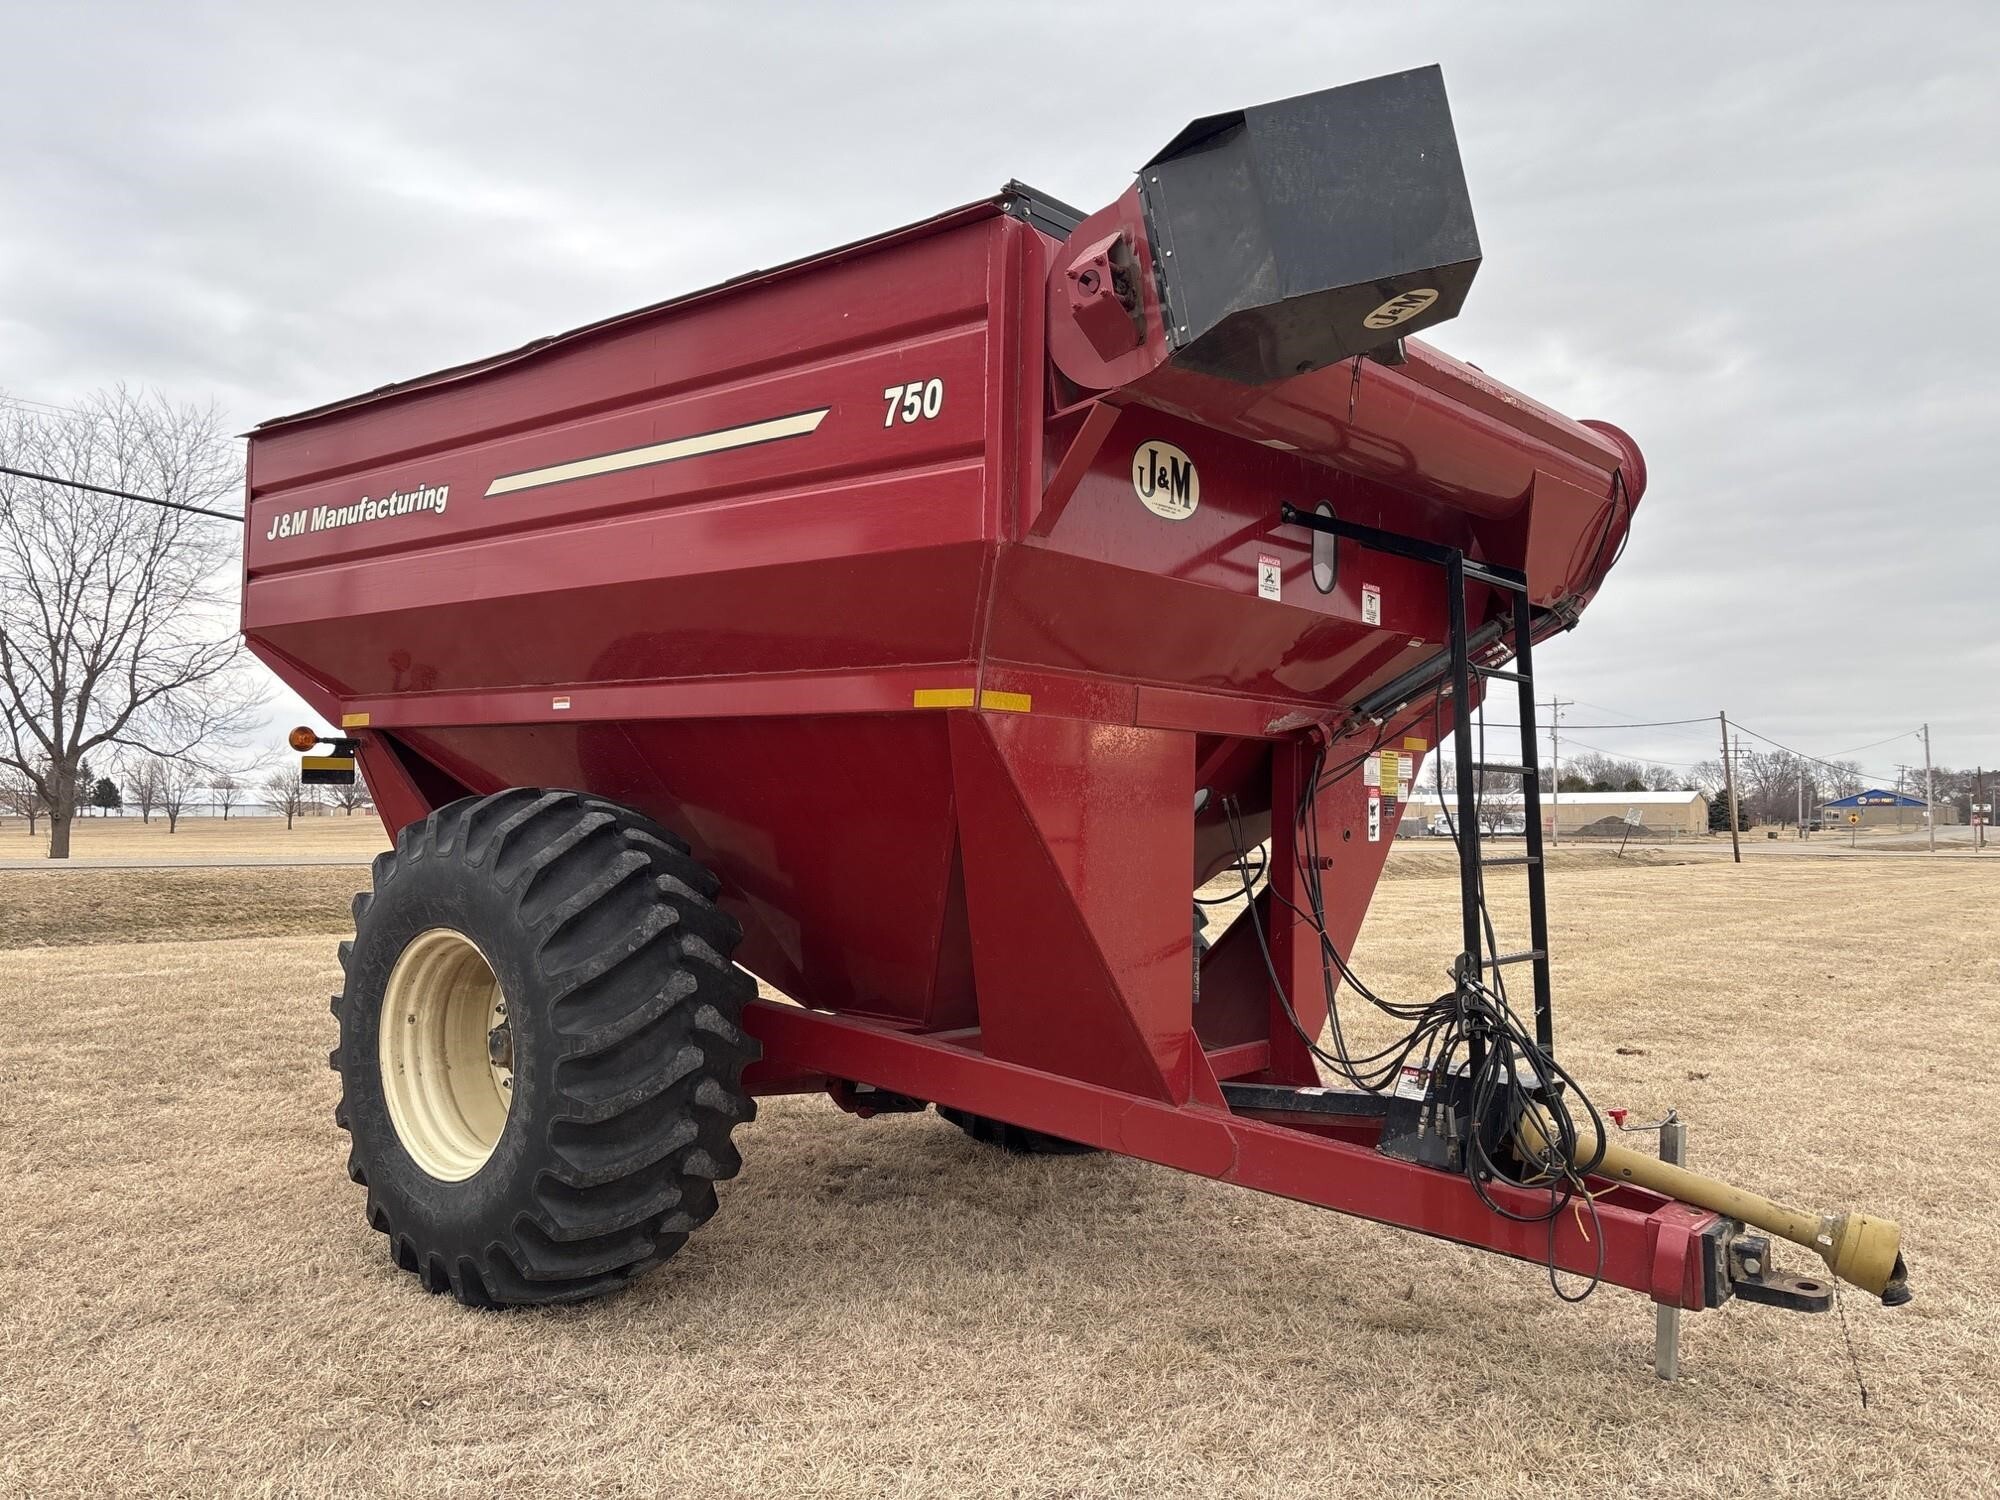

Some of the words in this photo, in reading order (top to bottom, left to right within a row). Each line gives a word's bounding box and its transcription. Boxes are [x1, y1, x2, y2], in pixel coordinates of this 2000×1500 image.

[1370, 294, 1434, 326] J&M
[883, 377, 944, 428] 750
[1138, 448, 1192, 510] J&M
[266, 509, 309, 541] J&M
[310, 484, 450, 531] Manufacturing
